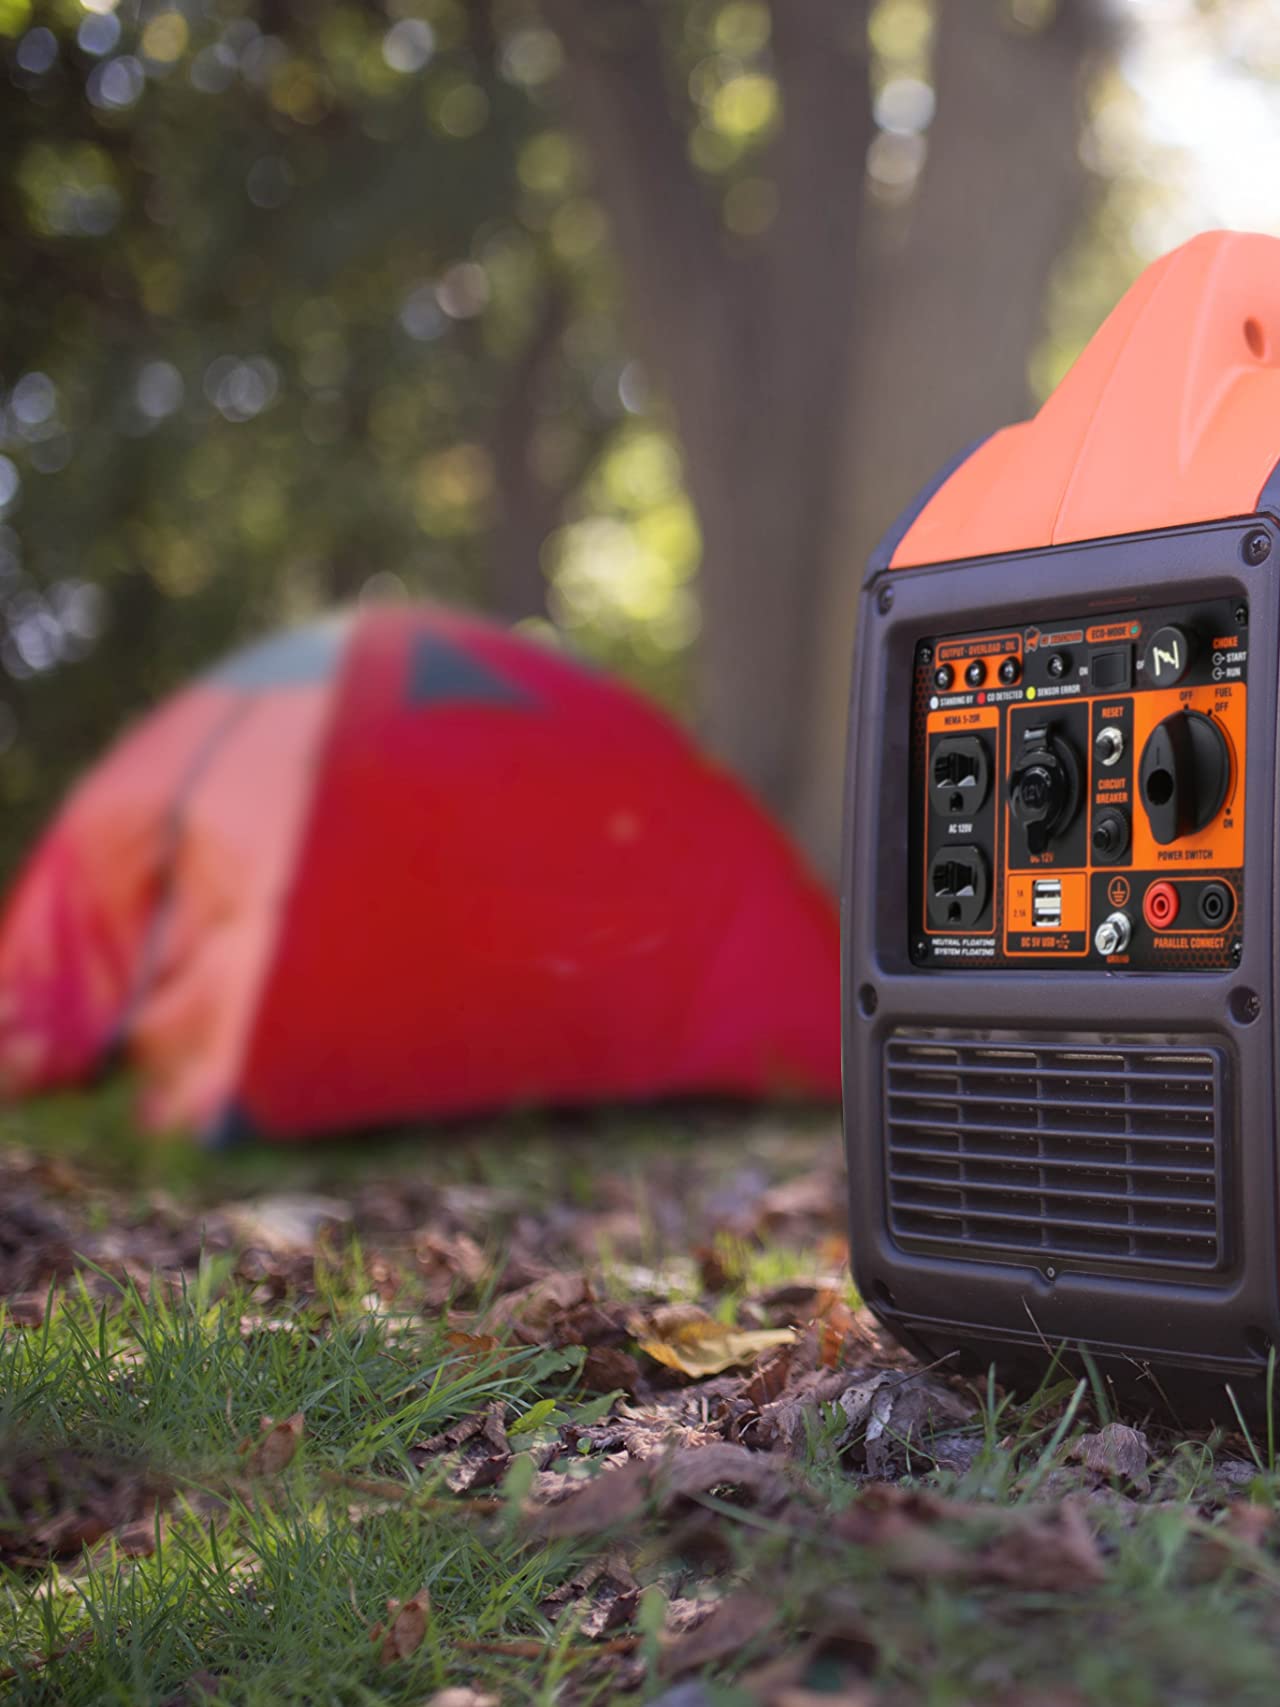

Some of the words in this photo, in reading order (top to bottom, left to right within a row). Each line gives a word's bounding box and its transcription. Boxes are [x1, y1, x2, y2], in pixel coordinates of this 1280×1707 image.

[1091, 627, 1126, 639] ECO-MODE
[1212, 636, 1238, 649] CHOKE
[941, 647, 964, 659] OUTPUT
[969, 642, 1001, 655] OVERLOAD
[1005, 641, 1016, 651] OIL
[1226, 651, 1247, 663] START
[1079, 666, 1088, 676] ON
[1226, 667, 1241, 678] RUN
[1038, 686, 1059, 696] SENSOR
[1060, 684, 1080, 694] ERROR
[1180, 690, 1194, 701] OFF
[1214, 687, 1232, 698] FUEL
[940, 696, 965, 706] STANDING
[966, 695, 974, 704] BY
[987, 692, 995, 702] CO
[996, 690, 1023, 701] DETECTED
[1102, 706, 1124, 718] RESET
[1214, 702, 1229, 712] OFF
[944, 715, 961, 725] NEMA
[1098, 778, 1126, 790] CIRCUIT
[1096, 792, 1128, 804] BREAKER
[948, 824, 957, 834] AC
[958, 823, 973, 833] 120V
[1224, 819, 1233, 828] ON
[1158, 850, 1183, 861] POWER
[1185, 849, 1213, 860] SWITCH
[932, 938, 960, 946] NEUTRAL
[962, 938, 995, 946] FLOATING
[1021, 937, 1030, 947] DC
[1031, 937, 1040, 947] 5V
[1041, 936, 1055, 947] USB
[1153, 937, 1189, 948] PARALLEL
[1191, 937, 1225, 948] CONNECT
[934, 948, 960, 956] SYSTEM
[961, 947, 994, 956] FLOATING
